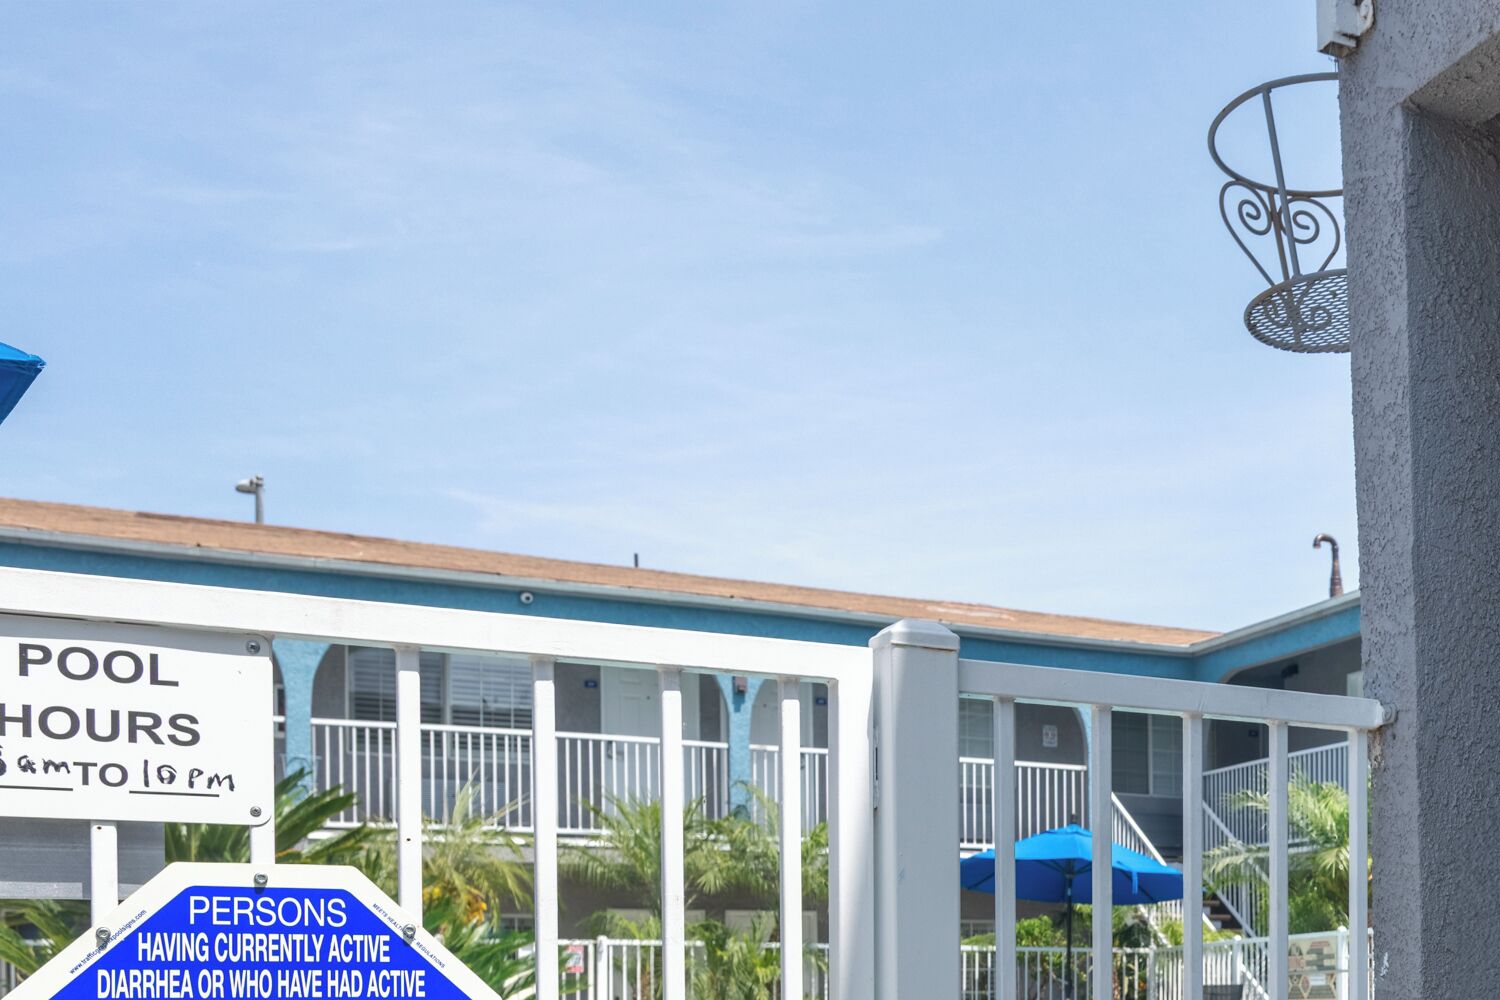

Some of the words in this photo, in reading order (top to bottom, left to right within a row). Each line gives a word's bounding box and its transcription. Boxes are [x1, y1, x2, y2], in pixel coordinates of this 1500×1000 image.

[19, 643, 179, 687] POOL
[0, 703, 200, 746] HOURS
[73, 761, 129, 788] TO
[189, 896, 347, 927] PERSONS
[138, 932, 209, 962] HAVING
[214, 932, 324, 962] CURRENTLY
[328, 934, 390, 963] ACTIVE
[97, 969, 193, 999] DIARRHEA
[198, 969, 225, 999] OR
[229, 969, 272, 999] WHO
[277, 970, 322, 999] HAVE
[327, 970, 363, 999] HAD
[367, 970, 425, 998] ACTIVE
